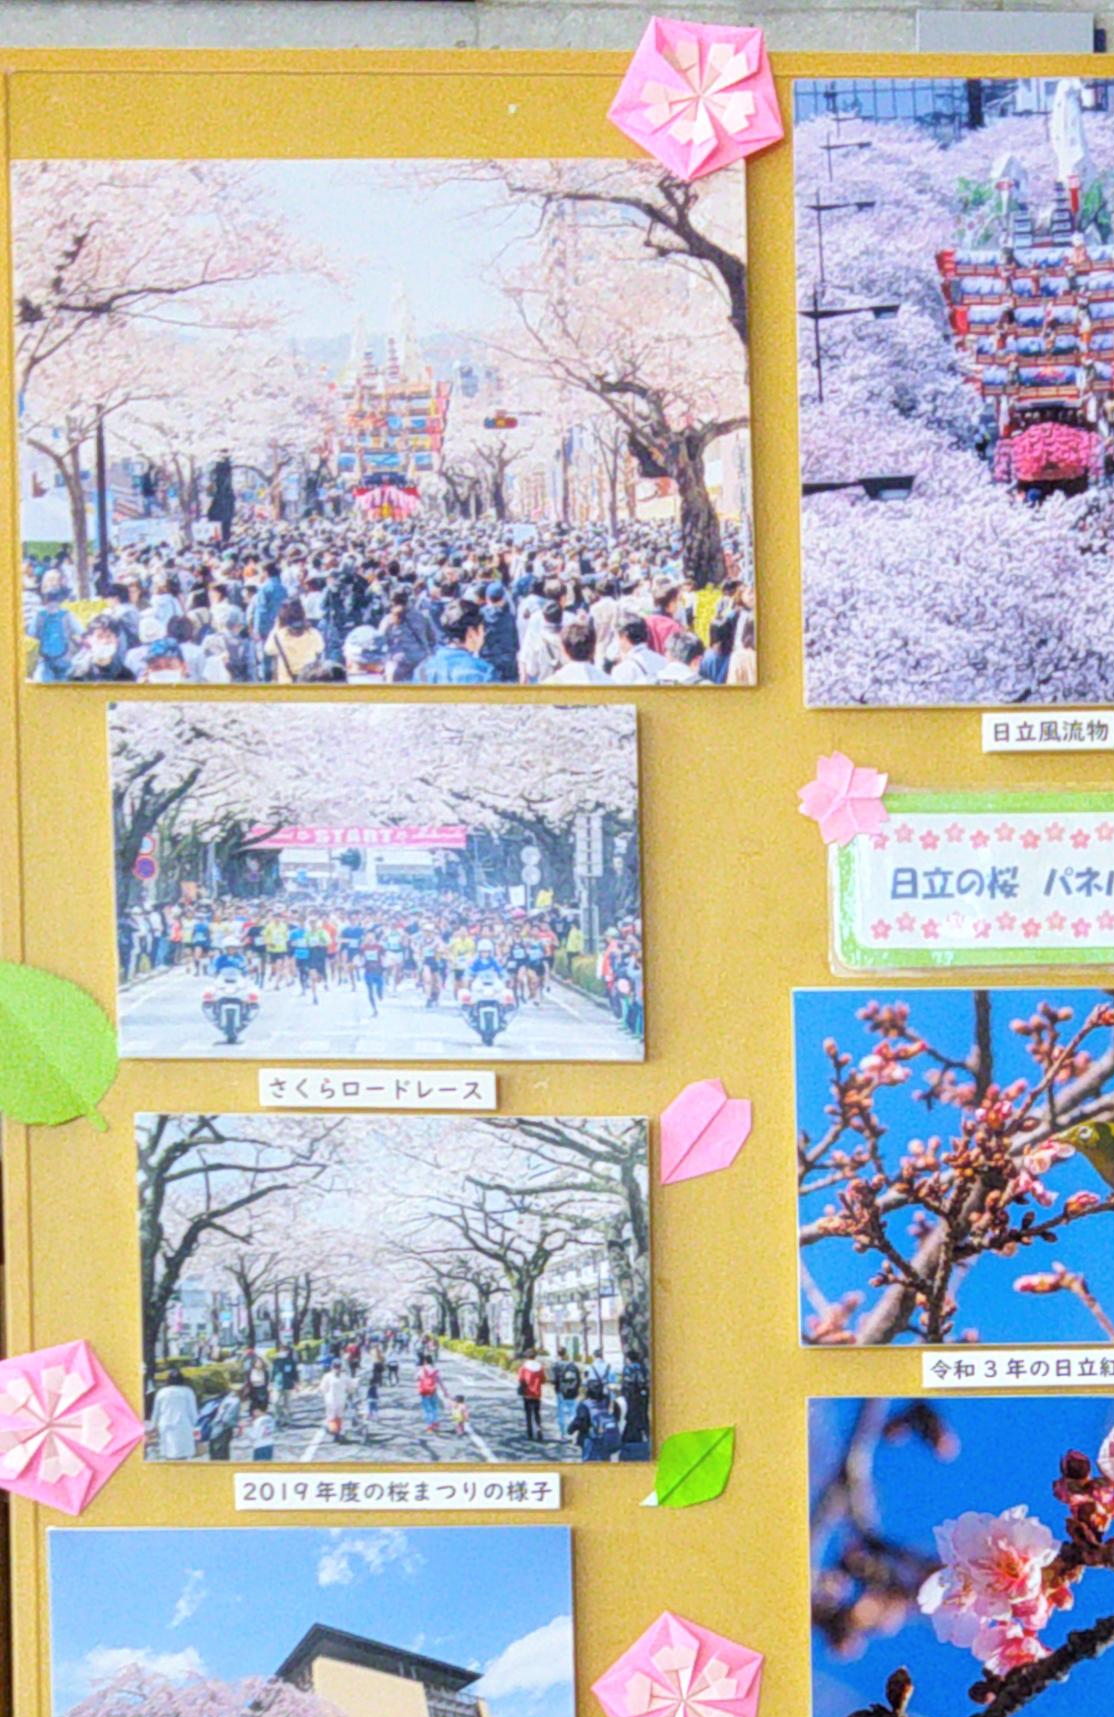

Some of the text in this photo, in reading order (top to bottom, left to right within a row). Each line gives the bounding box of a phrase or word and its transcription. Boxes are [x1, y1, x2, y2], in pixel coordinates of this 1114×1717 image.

[992, 719, 1110, 745] 日立風流物
[889, 866, 1021, 901] 日立の桜
[268, 1076, 484, 1101] さくらロードレース
[241, 1480, 554, 1505] 2019年度の桜まつりの様子
